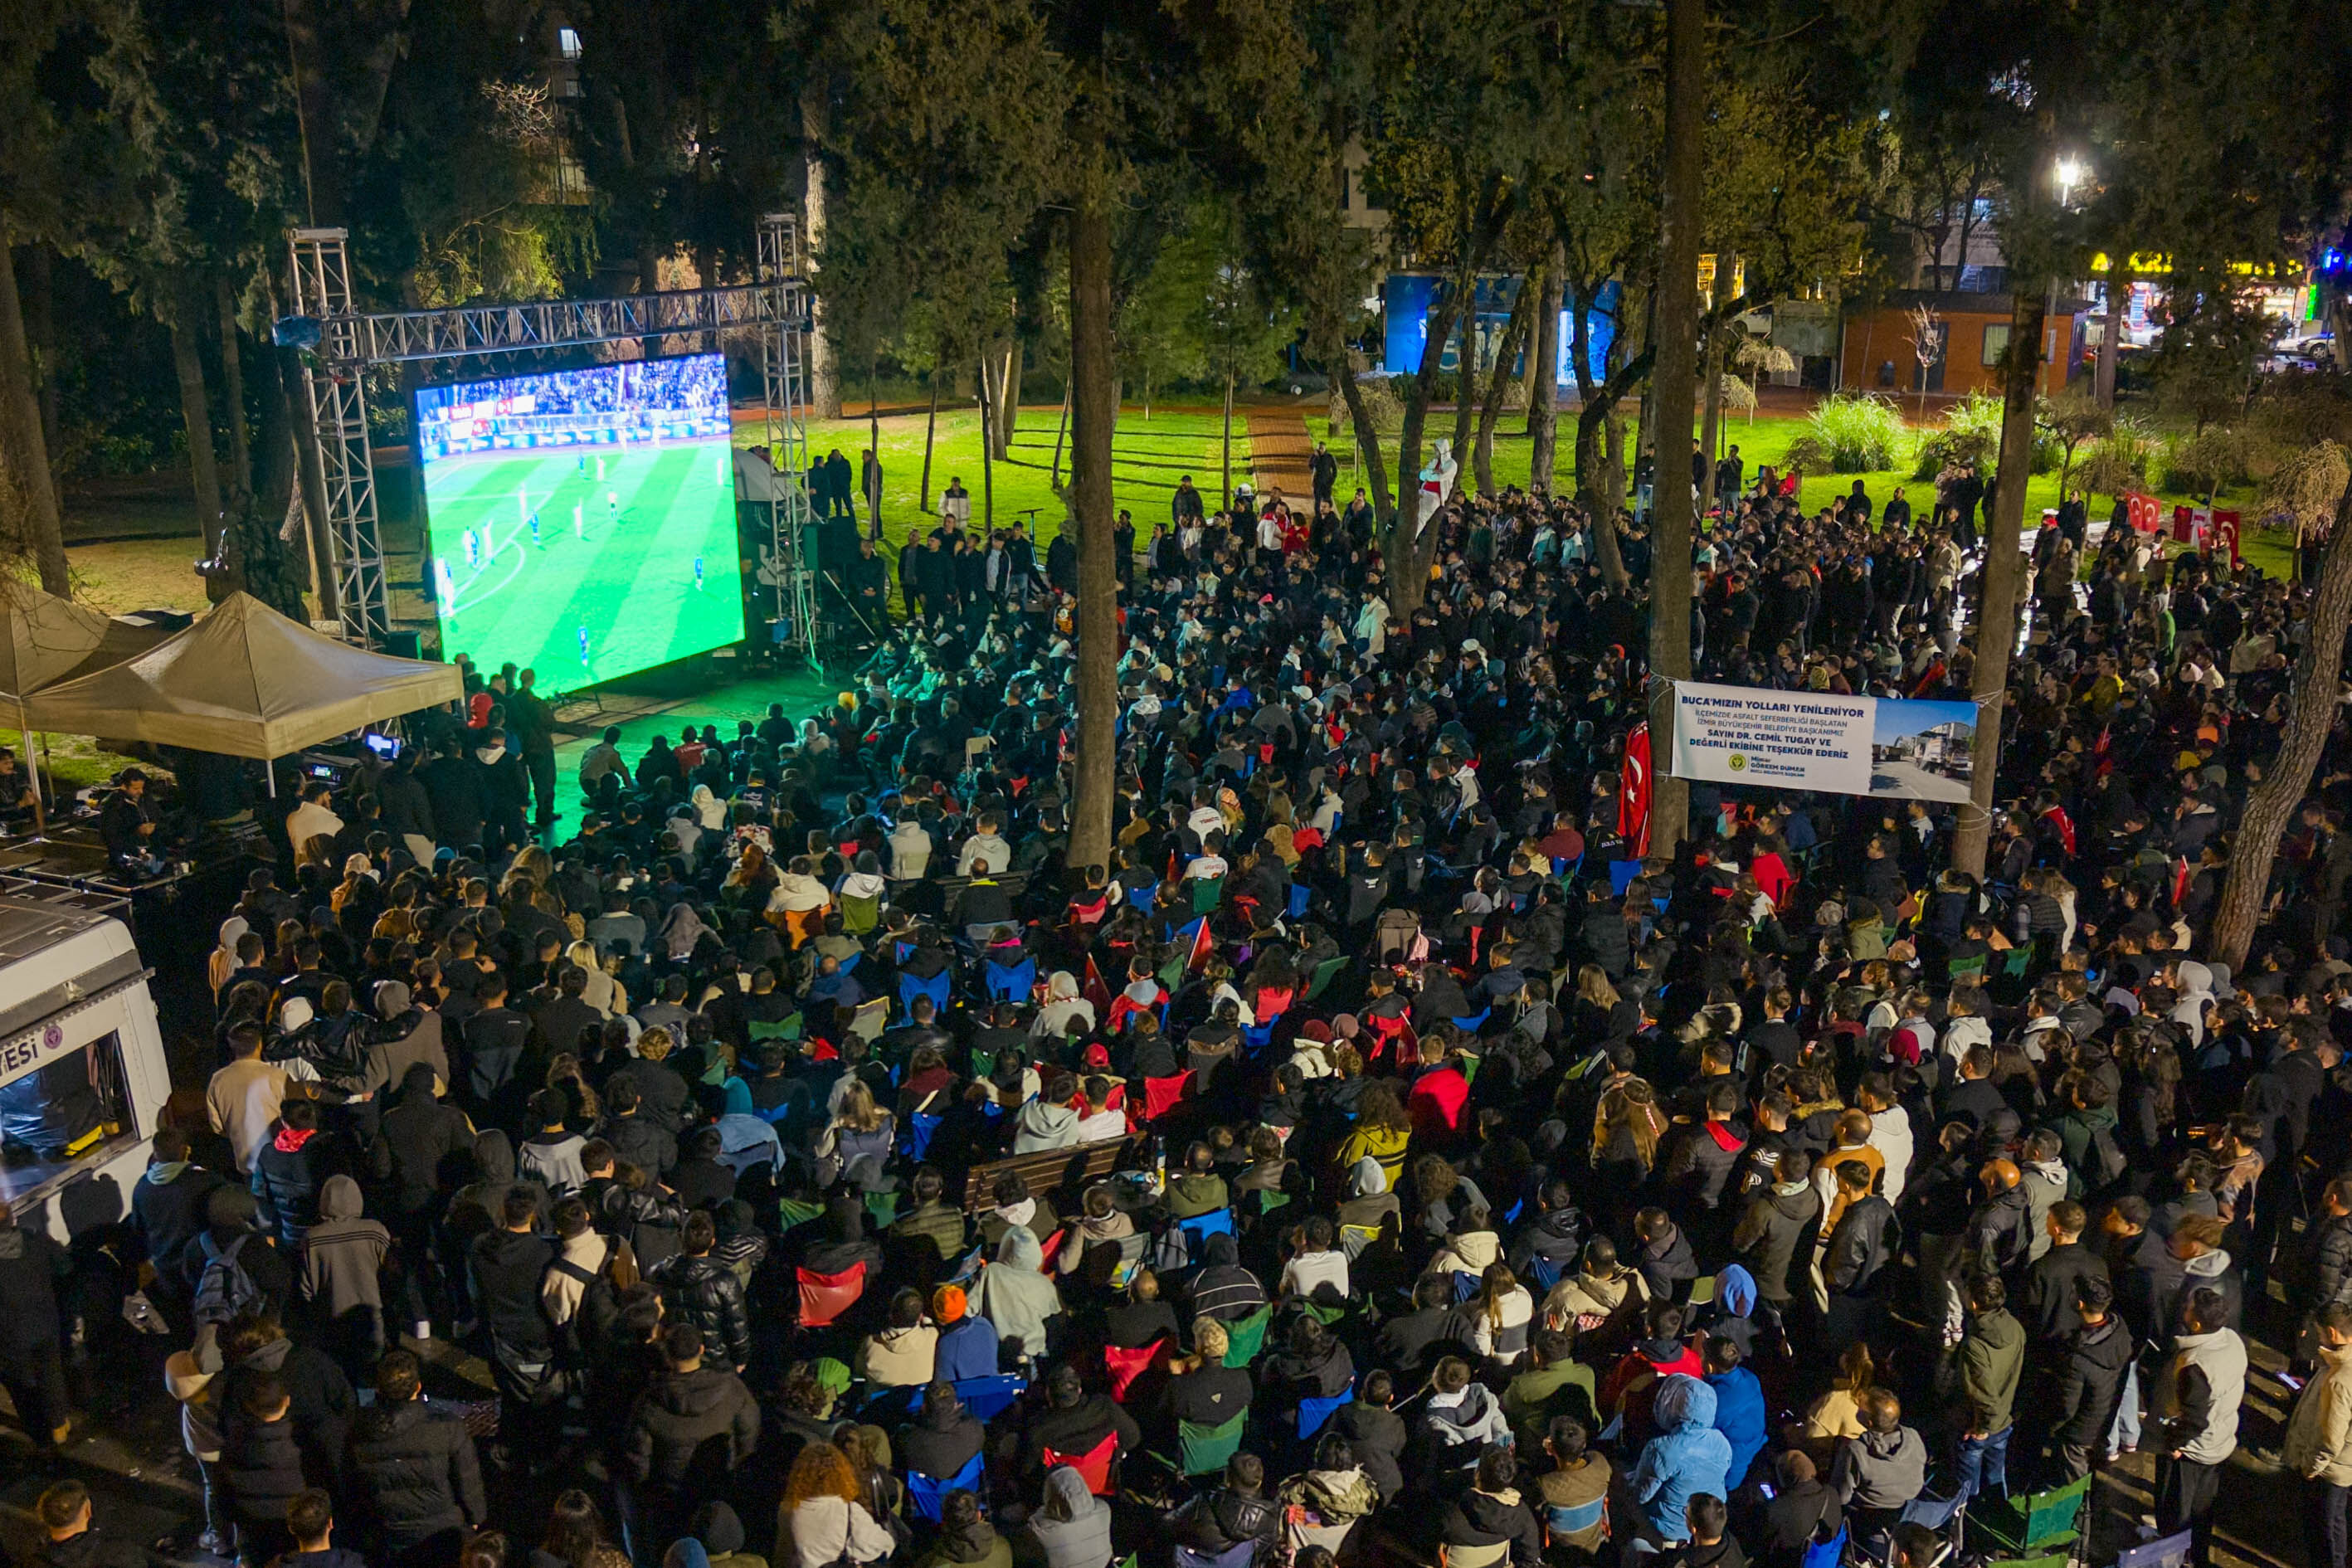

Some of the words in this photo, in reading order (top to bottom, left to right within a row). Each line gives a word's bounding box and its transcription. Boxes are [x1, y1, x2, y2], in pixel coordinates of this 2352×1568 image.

[1682, 695, 1742, 709] BUCA'MIZIN
[1746, 700, 1790, 712] YOLLARI
[1793, 703, 1864, 718] YENİLENİYOR
[1695, 709, 1731, 719] İLÇEMİZDE
[1732, 712, 1758, 721] ASFALT
[1760, 713, 1809, 724] SEFERBERLİĞİ
[1809, 718, 1848, 728] BAŞLATAN
[1697, 717, 1717, 727] İZMİR
[1717, 718, 1762, 731] BÜYÜKŞEHİR
[1764, 723, 1797, 733] BELEDİYE
[1707, 729, 1734, 738] SAYIN
[1736, 732, 1752, 740] DR.
[1754, 732, 1782, 743] CEMİL
[1785, 736, 1817, 745] TUGAY
[1819, 738, 1831, 747] VE
[1689, 738, 1727, 748] DEĞERLİ
[1729, 741, 1764, 752] EKİBİNE
[1766, 745, 1813, 756] TEŞEKKÜR
[1815, 748, 1848, 759] EDERİZ
[0, 1038, 38, 1077] ESİ
